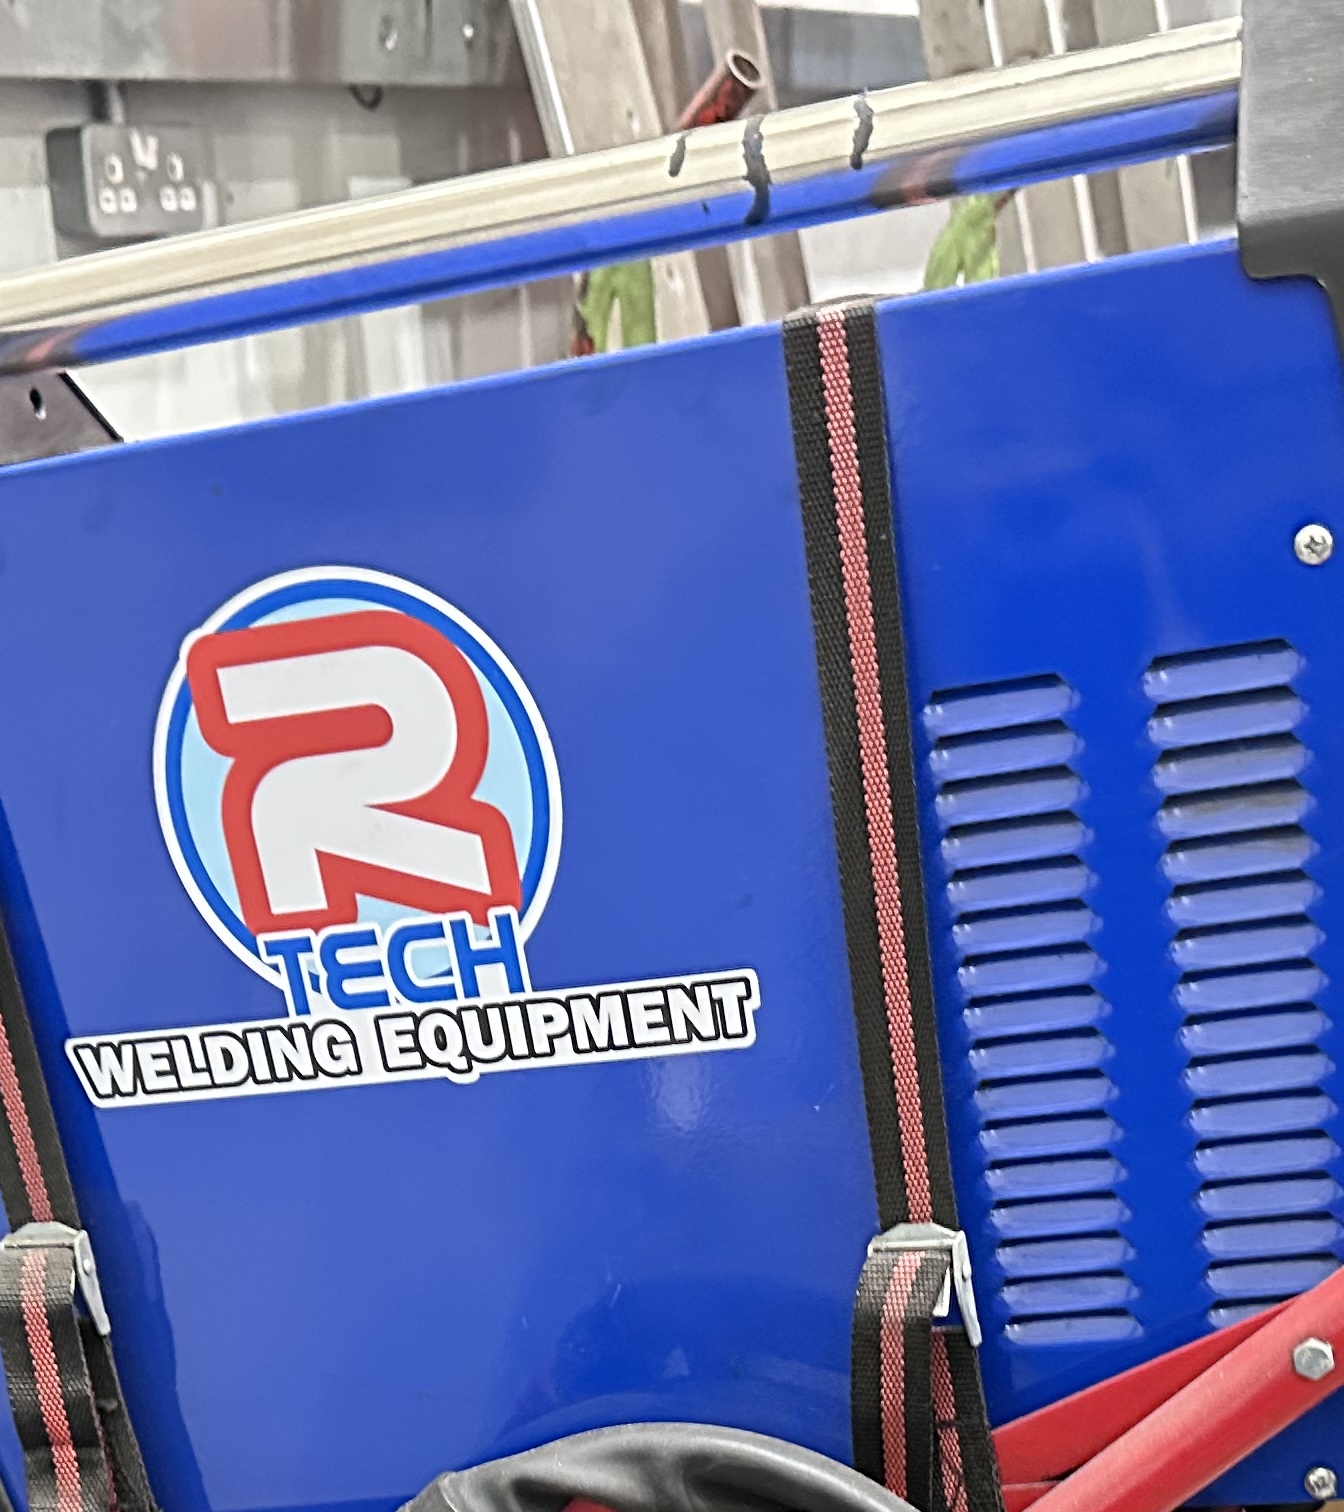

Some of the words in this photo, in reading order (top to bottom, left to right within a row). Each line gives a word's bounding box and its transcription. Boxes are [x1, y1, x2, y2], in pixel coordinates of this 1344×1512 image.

[263, 911, 524, 1016] TECH
[73, 1027, 358, 1100] WELDING
[375, 978, 752, 1074] EQUIPMENT
